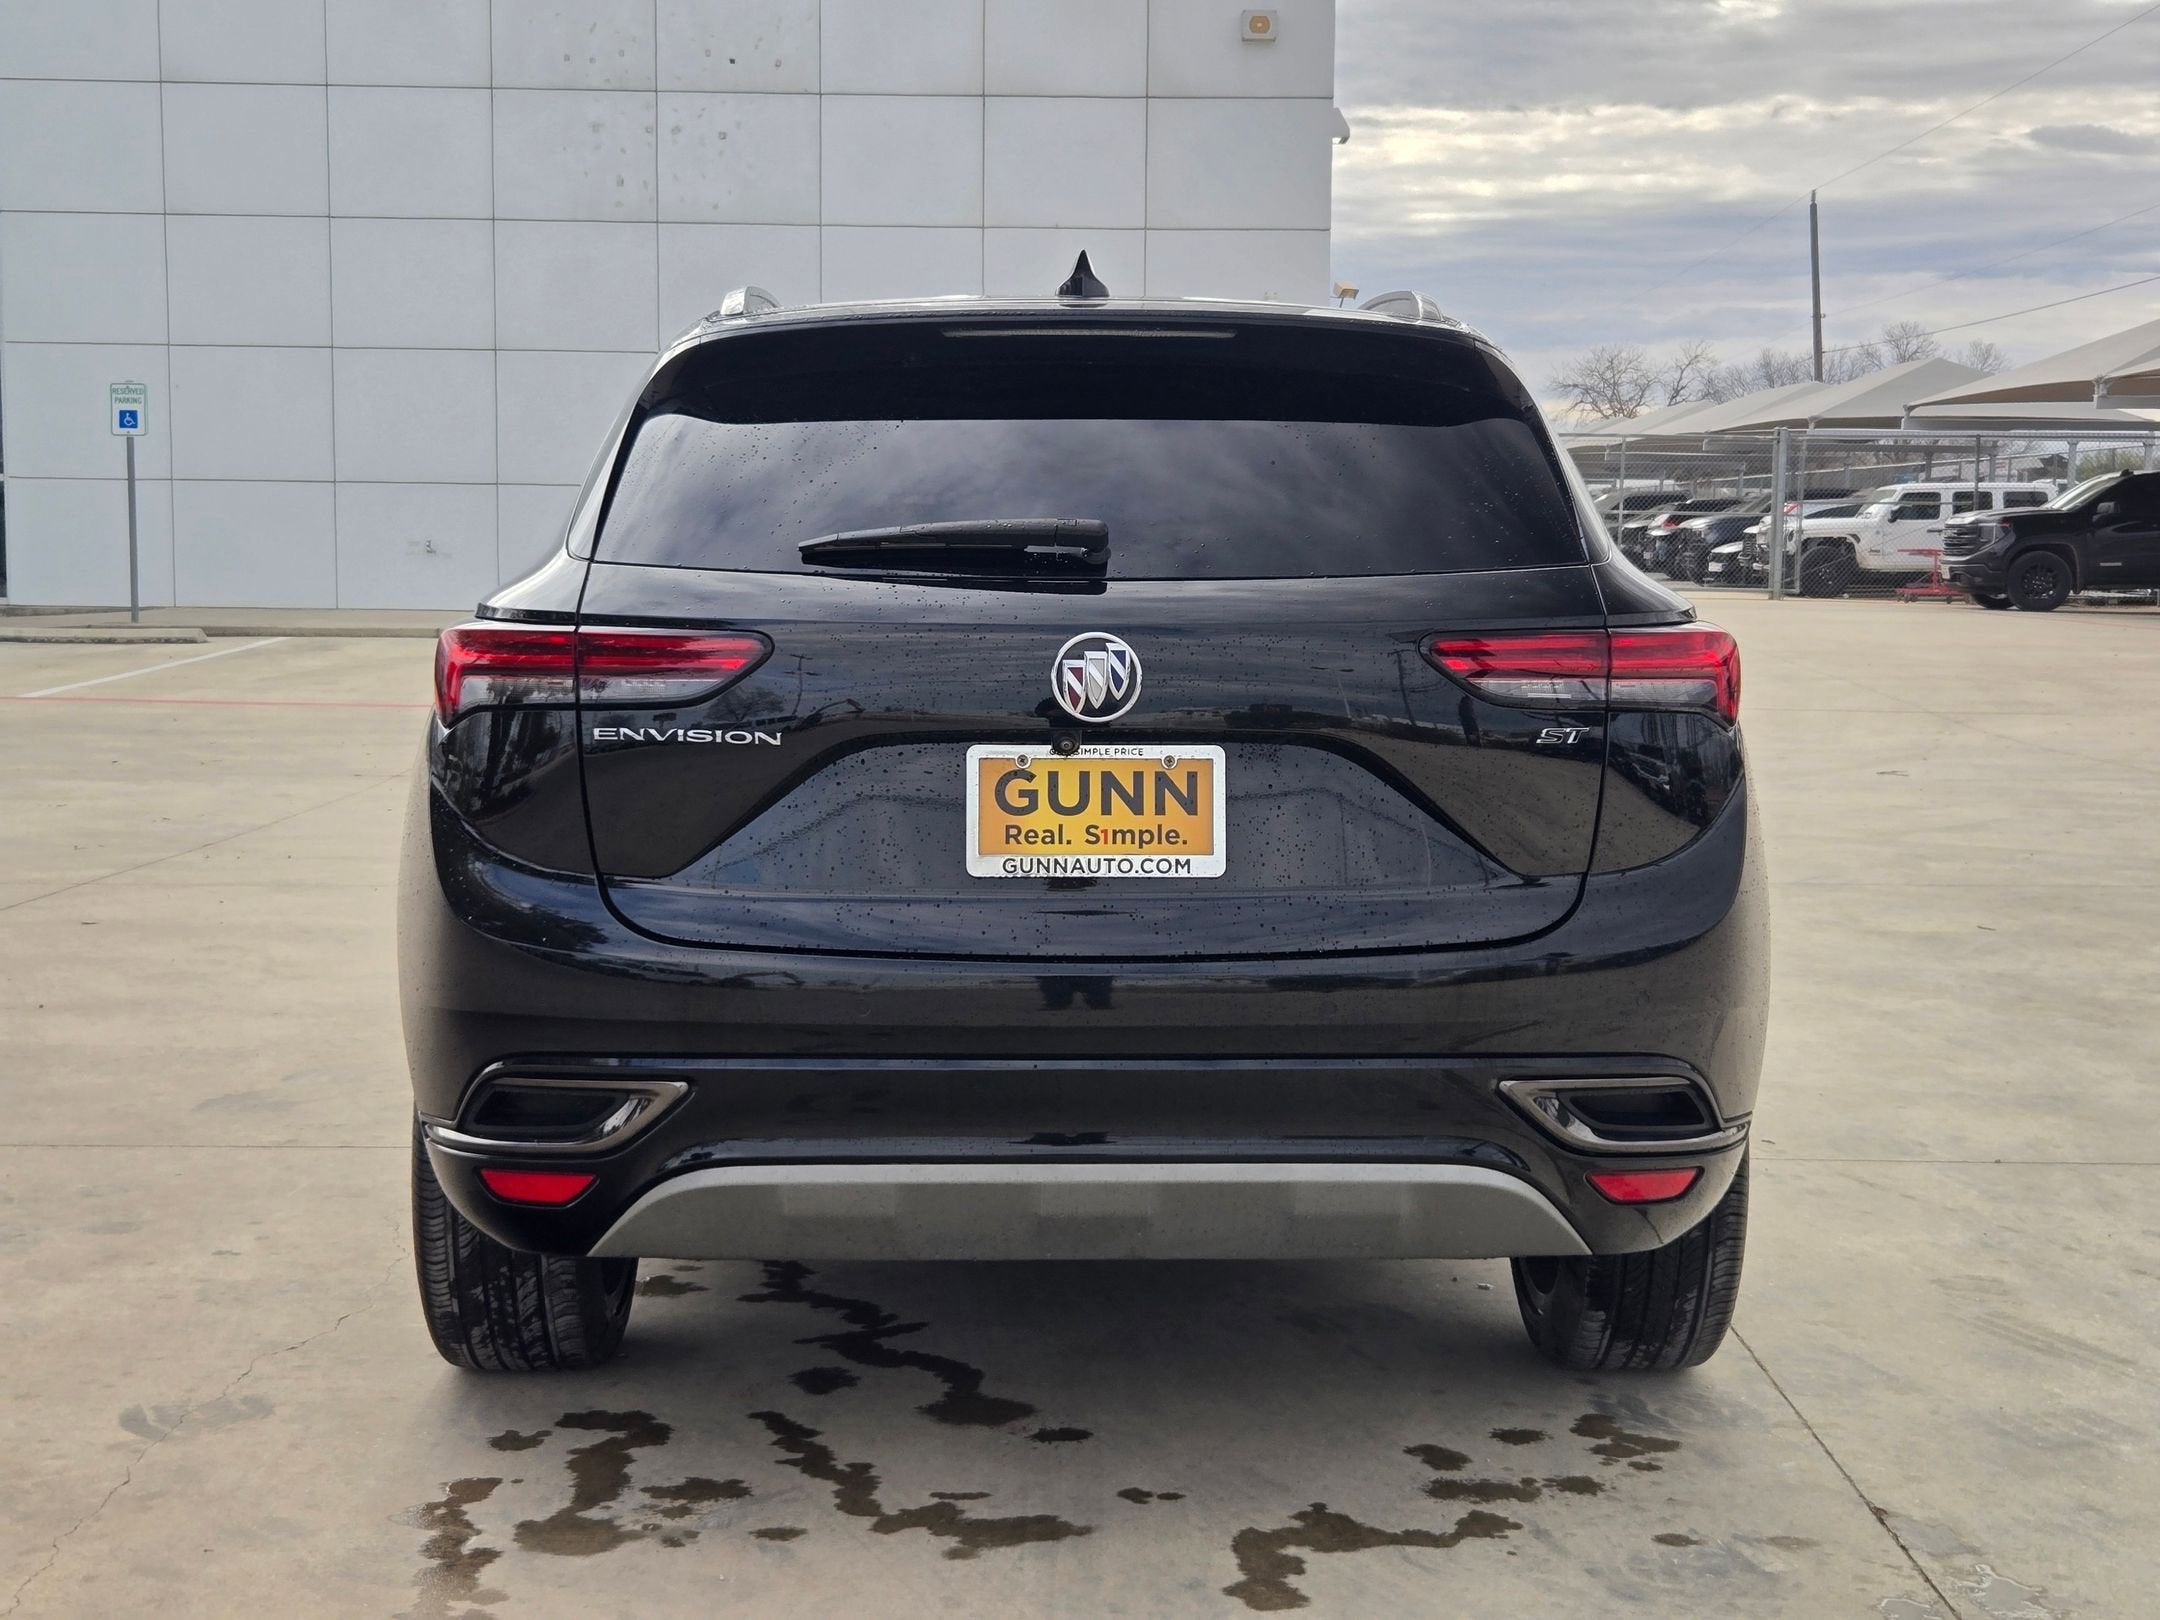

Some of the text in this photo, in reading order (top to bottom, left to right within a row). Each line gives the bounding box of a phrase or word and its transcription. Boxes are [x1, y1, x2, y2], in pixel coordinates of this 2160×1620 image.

[114, 396, 142, 404] PARKING
[593, 727, 782, 746] ENVISION
[1536, 727, 1591, 744] ST
[1114, 747, 1144, 756] PRICE
[994, 768, 1198, 817] GUNN
[1005, 824, 1188, 849] Real. S1mple.
[1002, 857, 1191, 875] GUNNAUTO.COM
